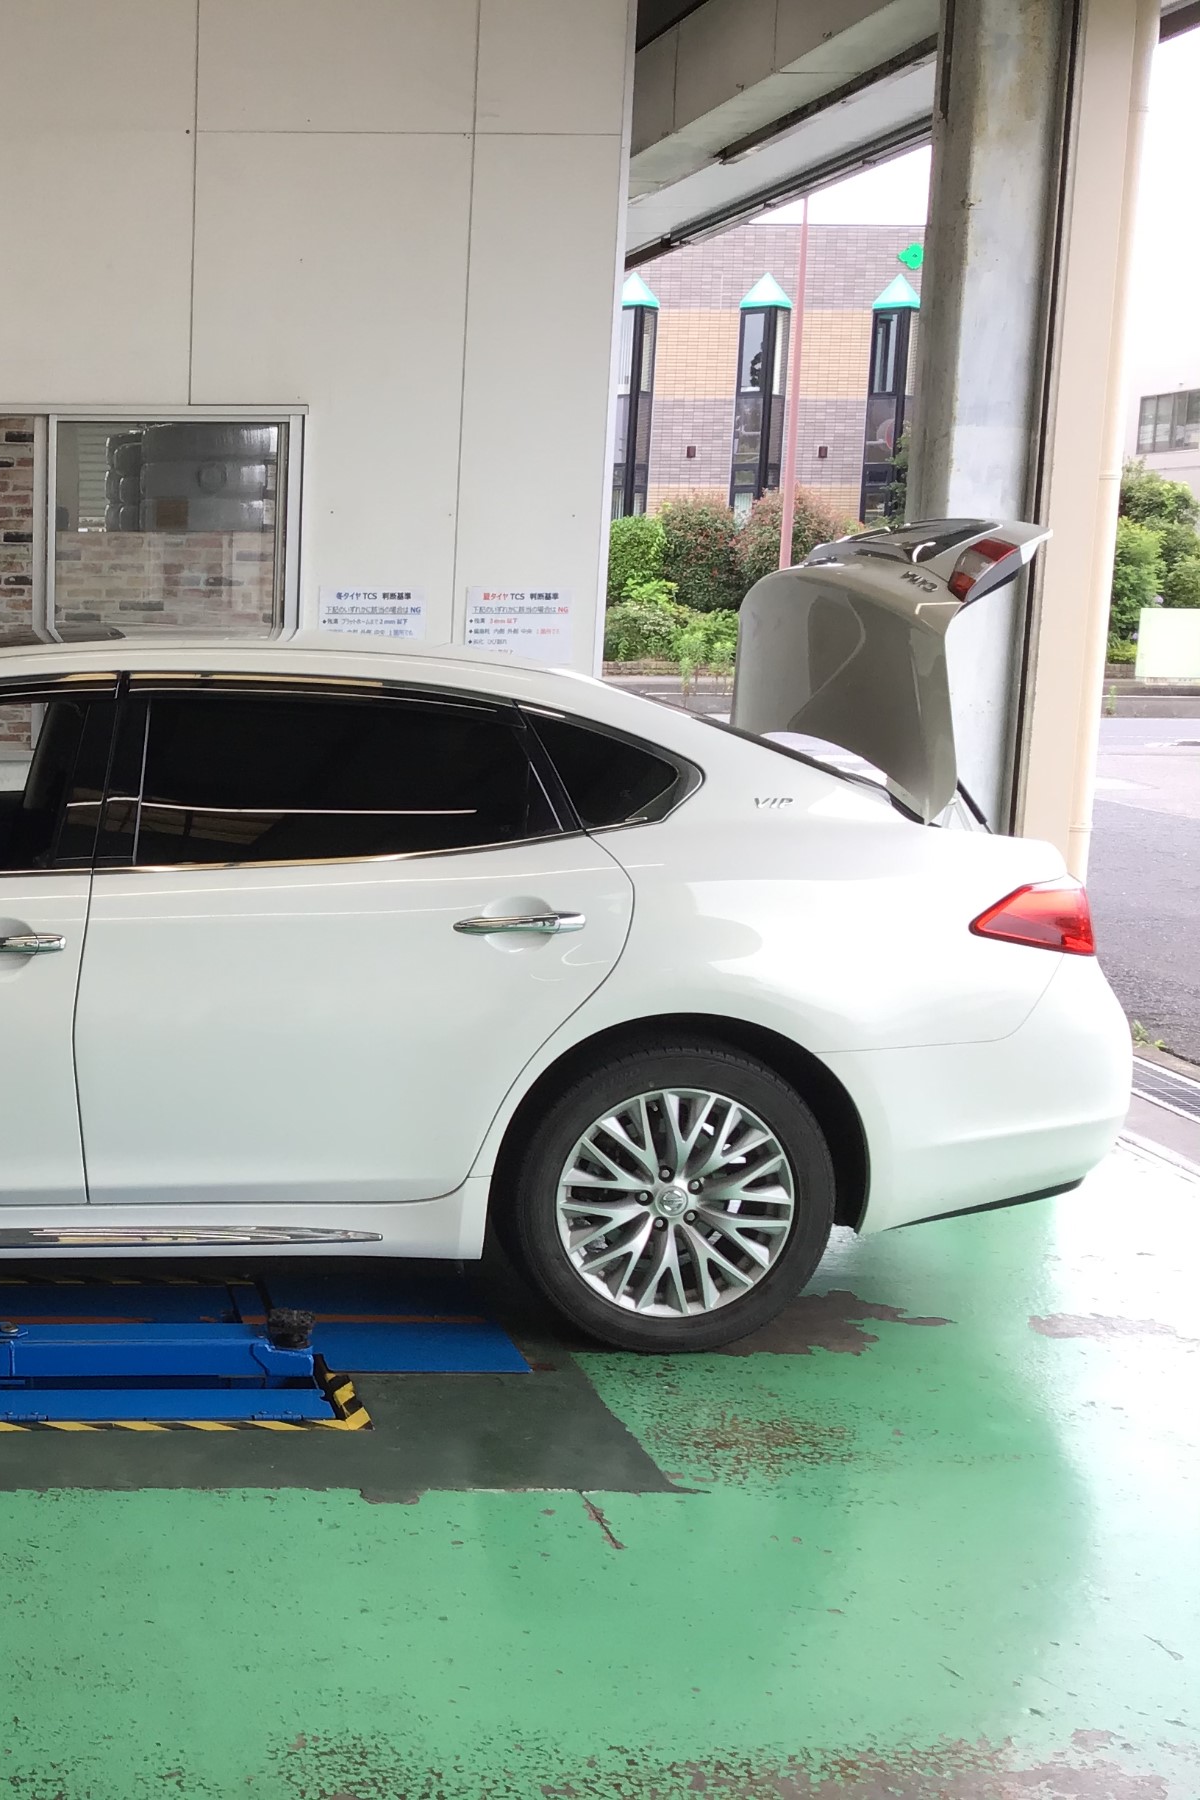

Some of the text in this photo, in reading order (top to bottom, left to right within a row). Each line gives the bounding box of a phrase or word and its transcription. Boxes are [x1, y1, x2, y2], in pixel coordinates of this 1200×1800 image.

[363, 592, 378, 600] TCS
[510, 593, 525, 601] TCS
[410, 606, 422, 614] NG
[557, 606, 569, 614] NG
[754, 797, 794, 809] VIP
